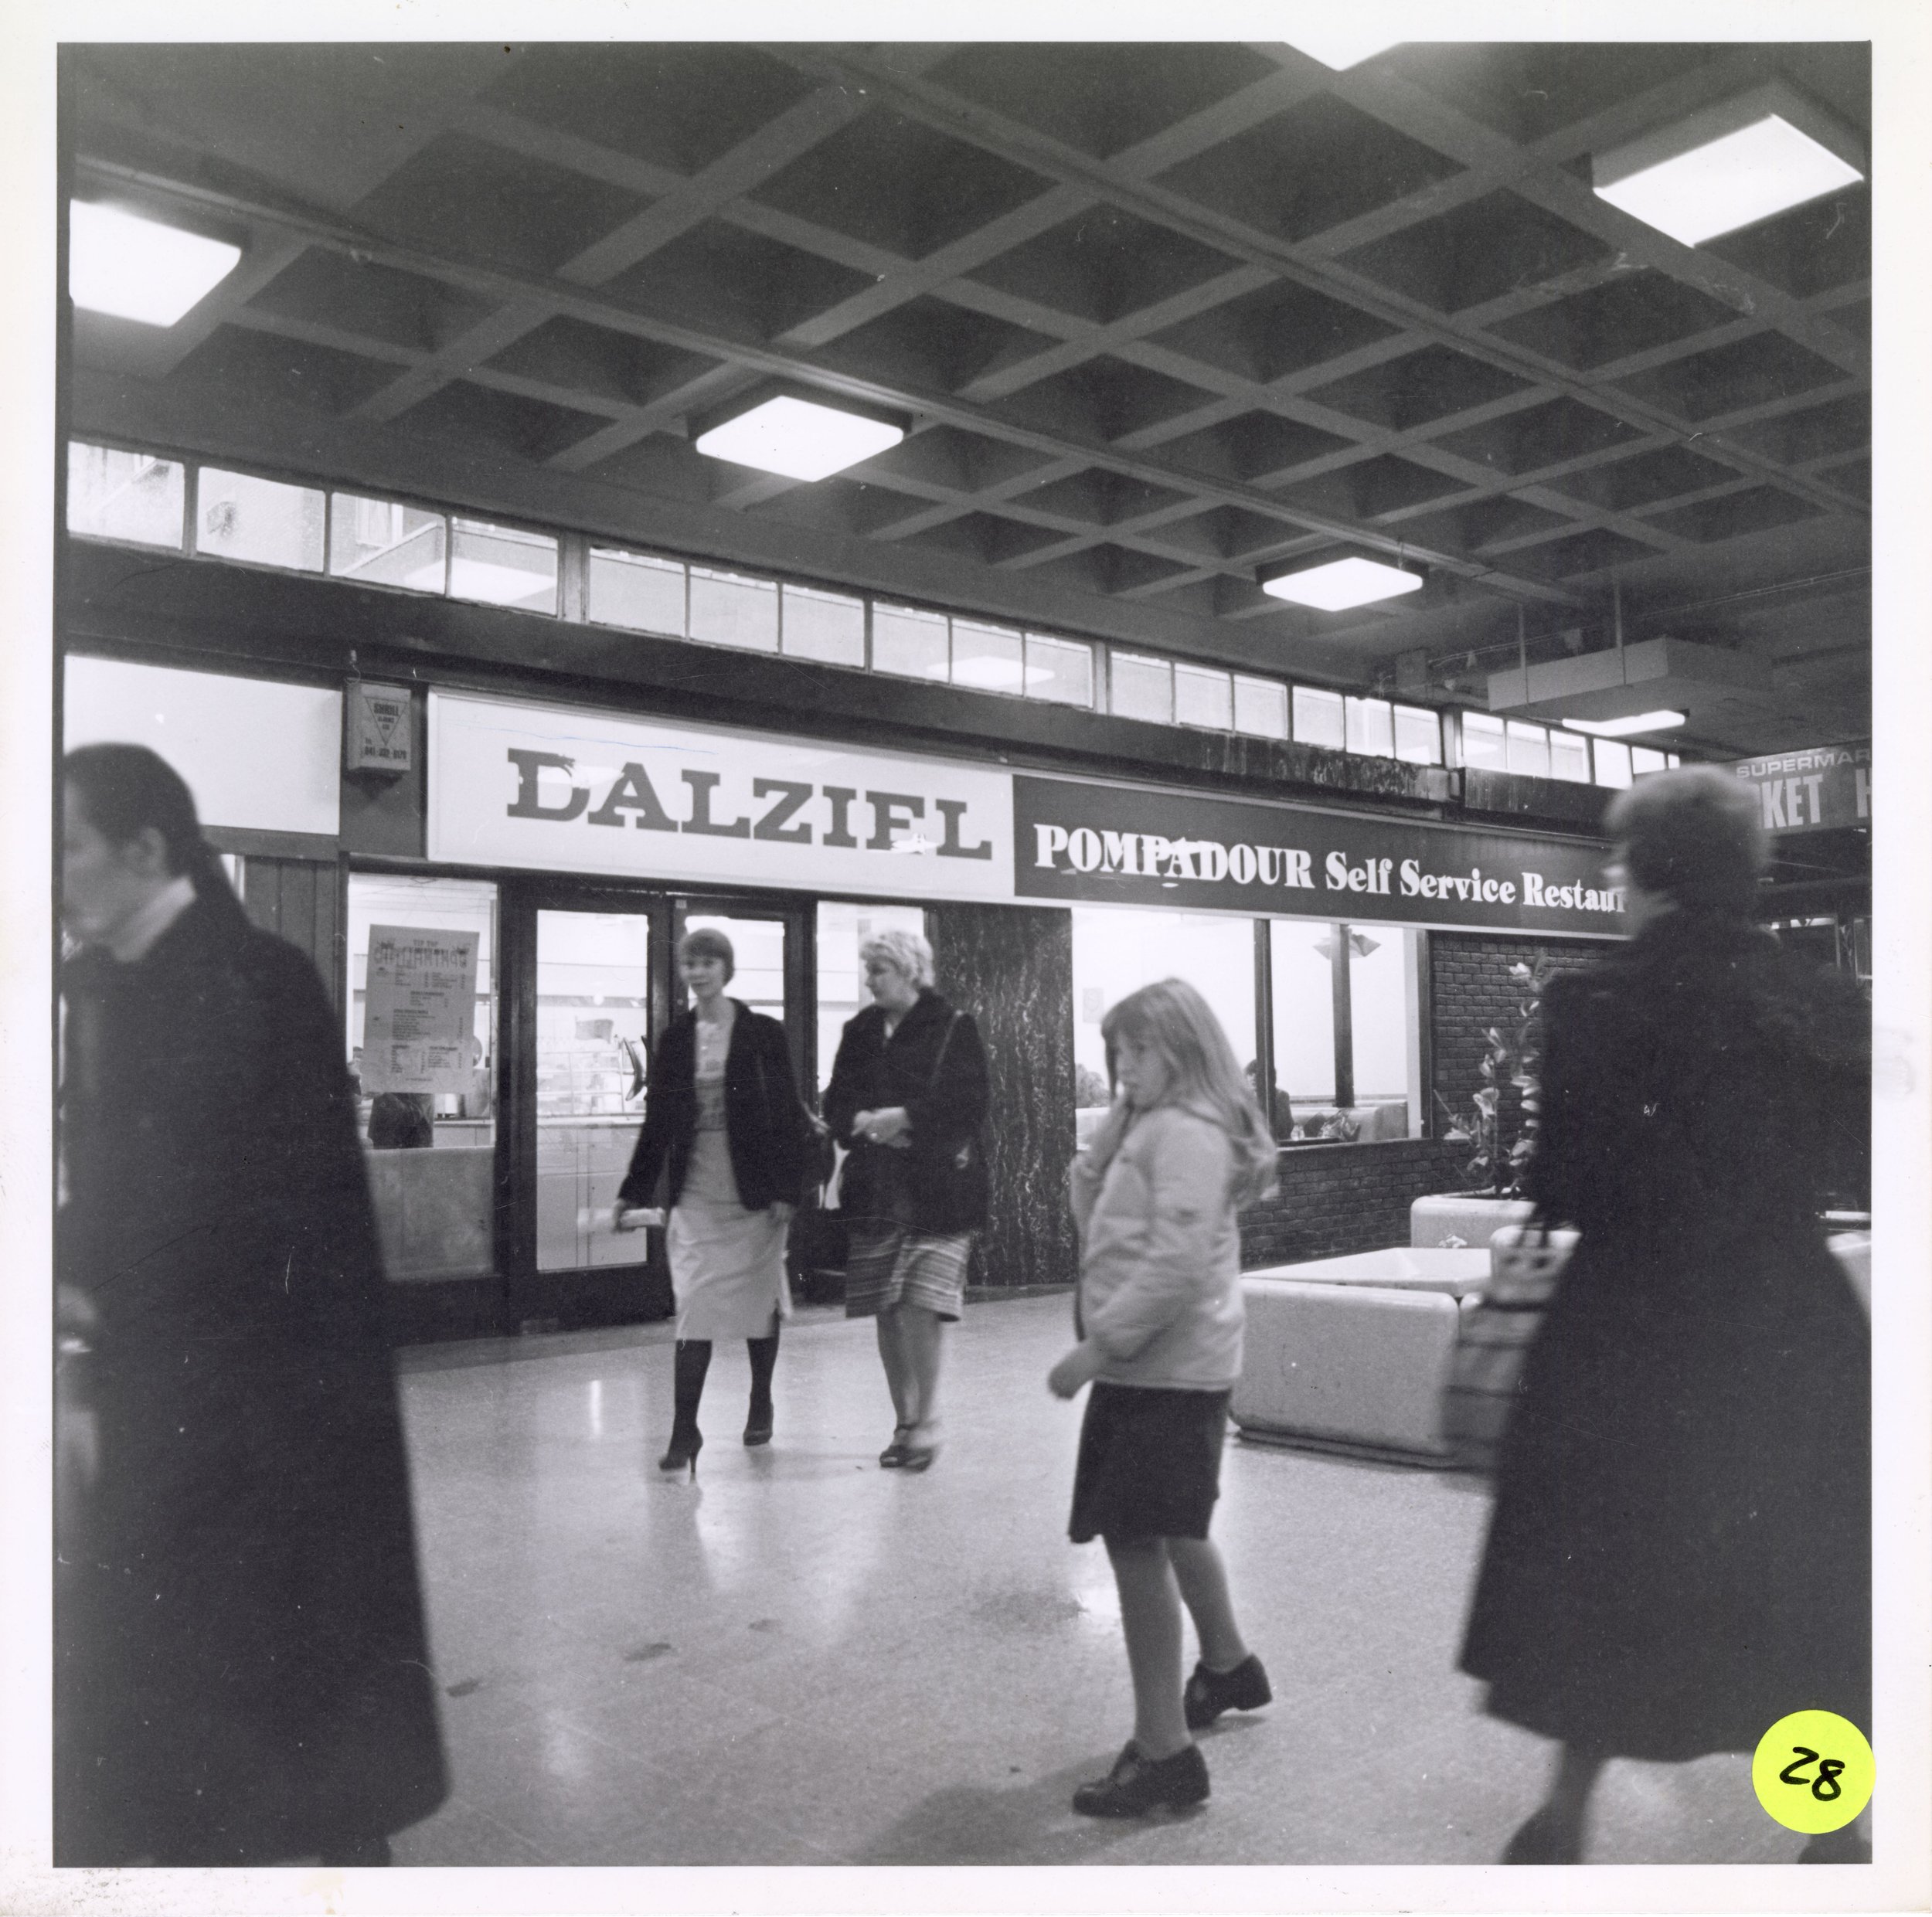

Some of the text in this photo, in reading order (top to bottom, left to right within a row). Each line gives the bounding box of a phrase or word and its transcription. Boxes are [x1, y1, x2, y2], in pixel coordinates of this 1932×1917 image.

[507, 747, 992, 861] DALZIEL
[1033, 824, 1315, 889] POMPADOUR
[1325, 851, 1393, 895] Self
[1400, 858, 1515, 904] Service
[1779, 1746, 1845, 1801] 28
